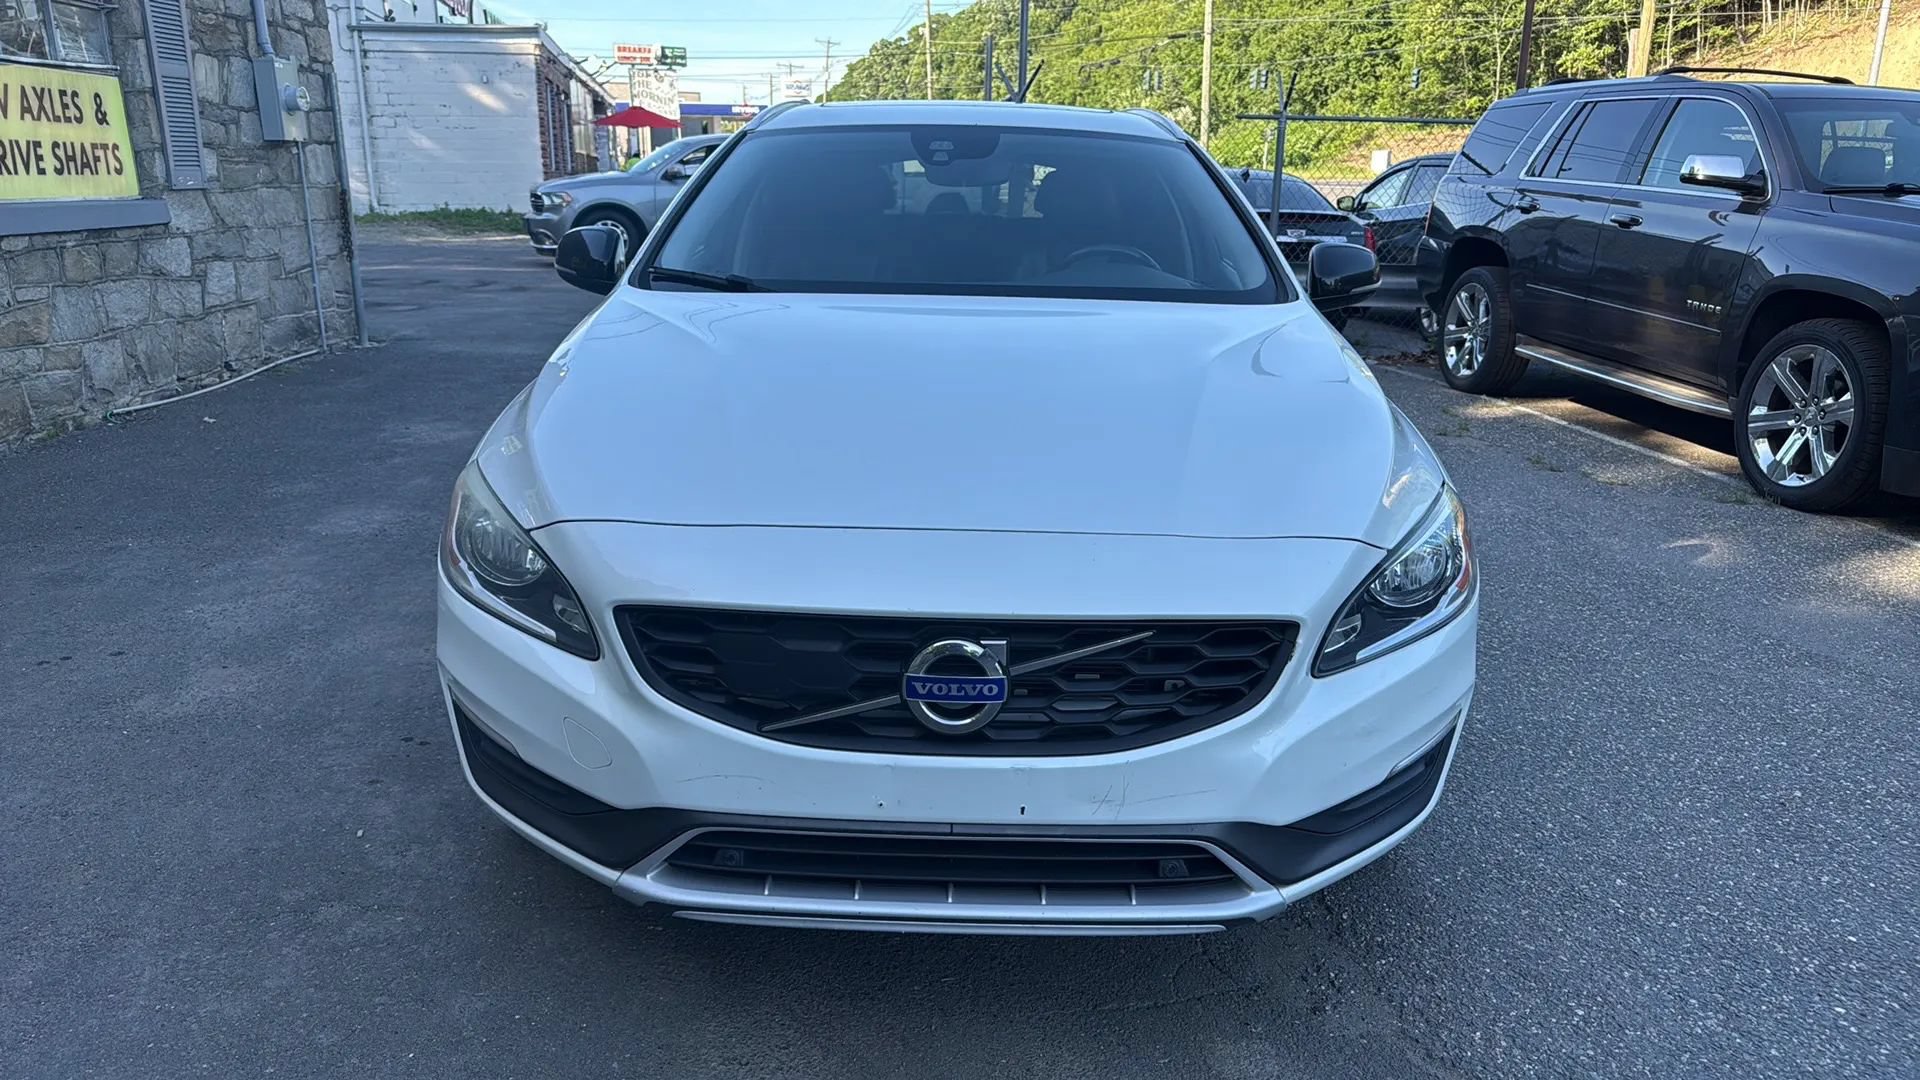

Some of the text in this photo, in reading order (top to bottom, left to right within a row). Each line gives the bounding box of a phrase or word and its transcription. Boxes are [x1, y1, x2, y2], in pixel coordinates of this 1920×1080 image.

[617, 46, 651, 54] BREAKFA
[20, 84, 84, 125] AXLES
[93, 92, 110, 126] &
[51, 140, 124, 176] SHAFTS
[1686, 299, 1722, 314] TAHOE
[912, 682, 999, 696] VOLVO
